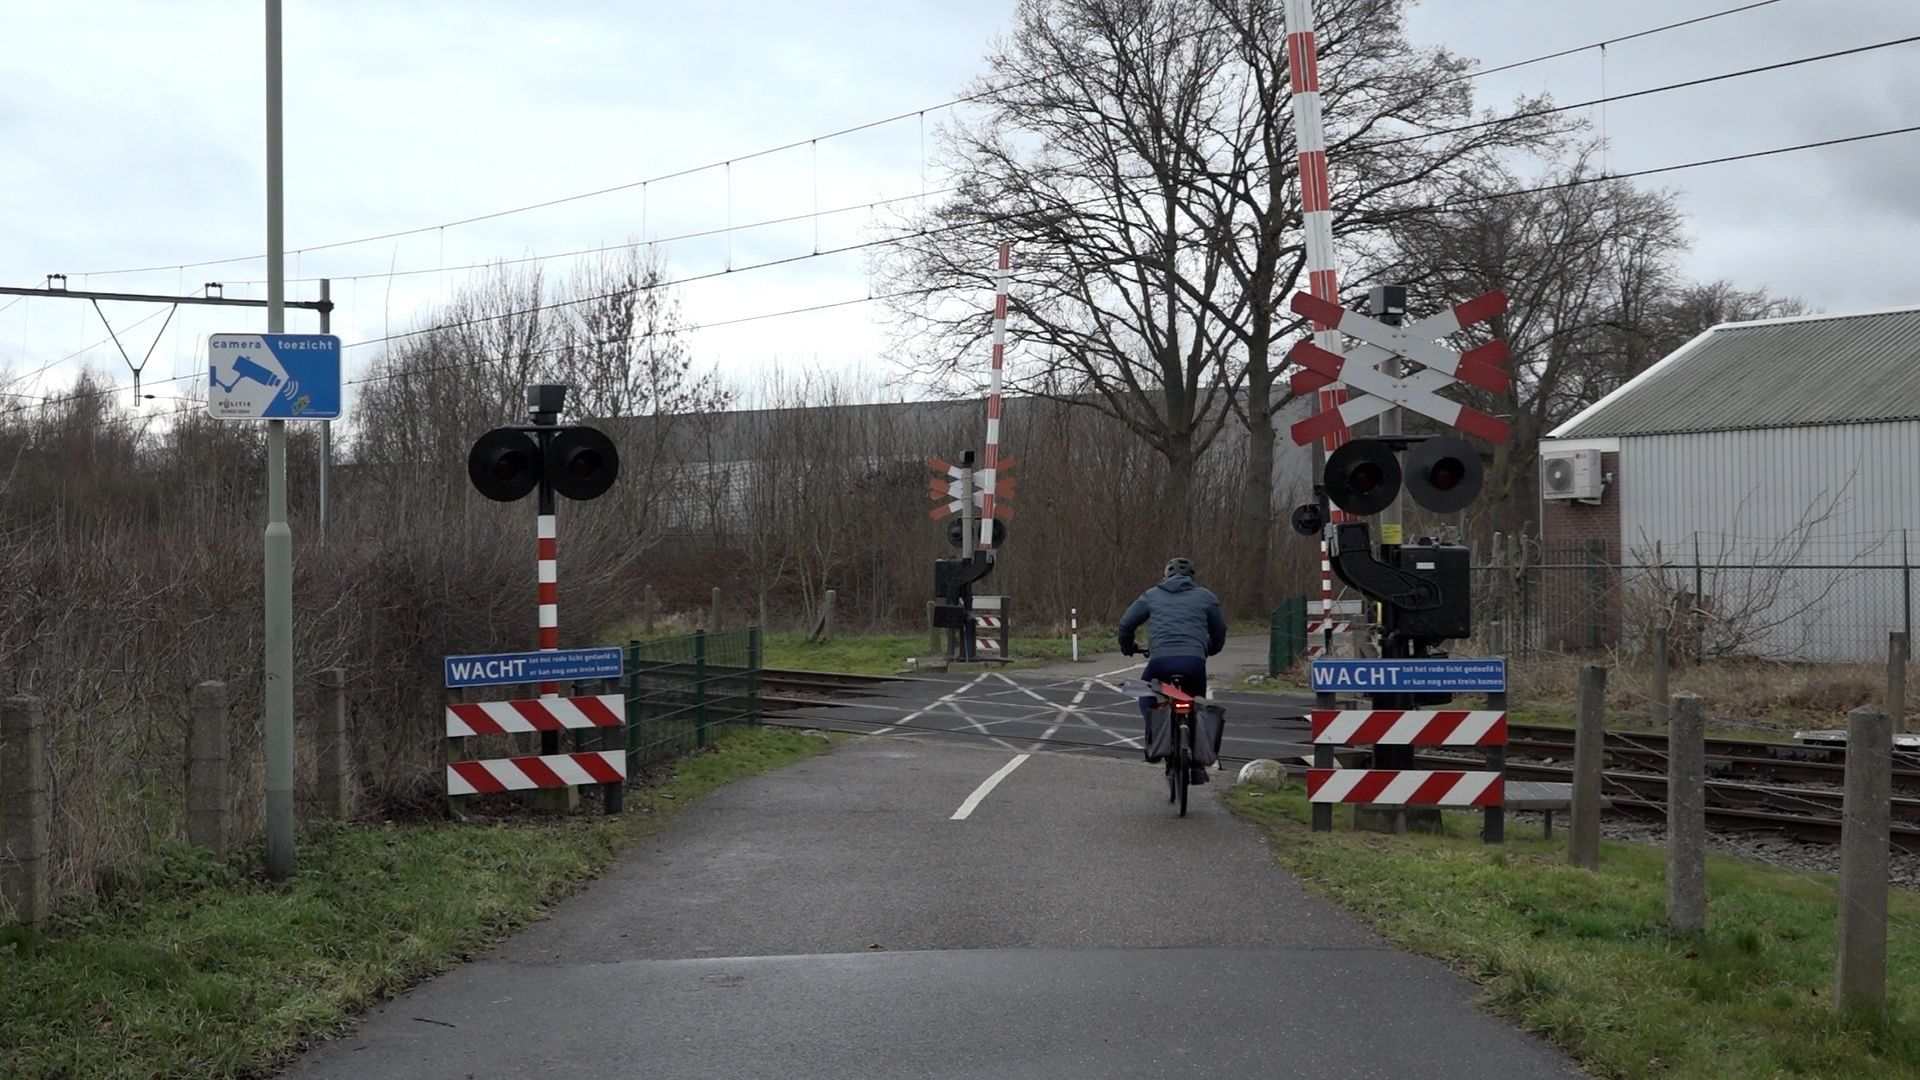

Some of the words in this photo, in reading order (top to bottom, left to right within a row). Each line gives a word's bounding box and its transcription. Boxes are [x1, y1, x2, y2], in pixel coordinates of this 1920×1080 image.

[213, 340, 261, 349] camera
[278, 340, 333, 350] toezicht
[218, 398, 250, 409] POLITIE
[451, 660, 527, 680] WACHT
[1314, 667, 1400, 685] WACHT
